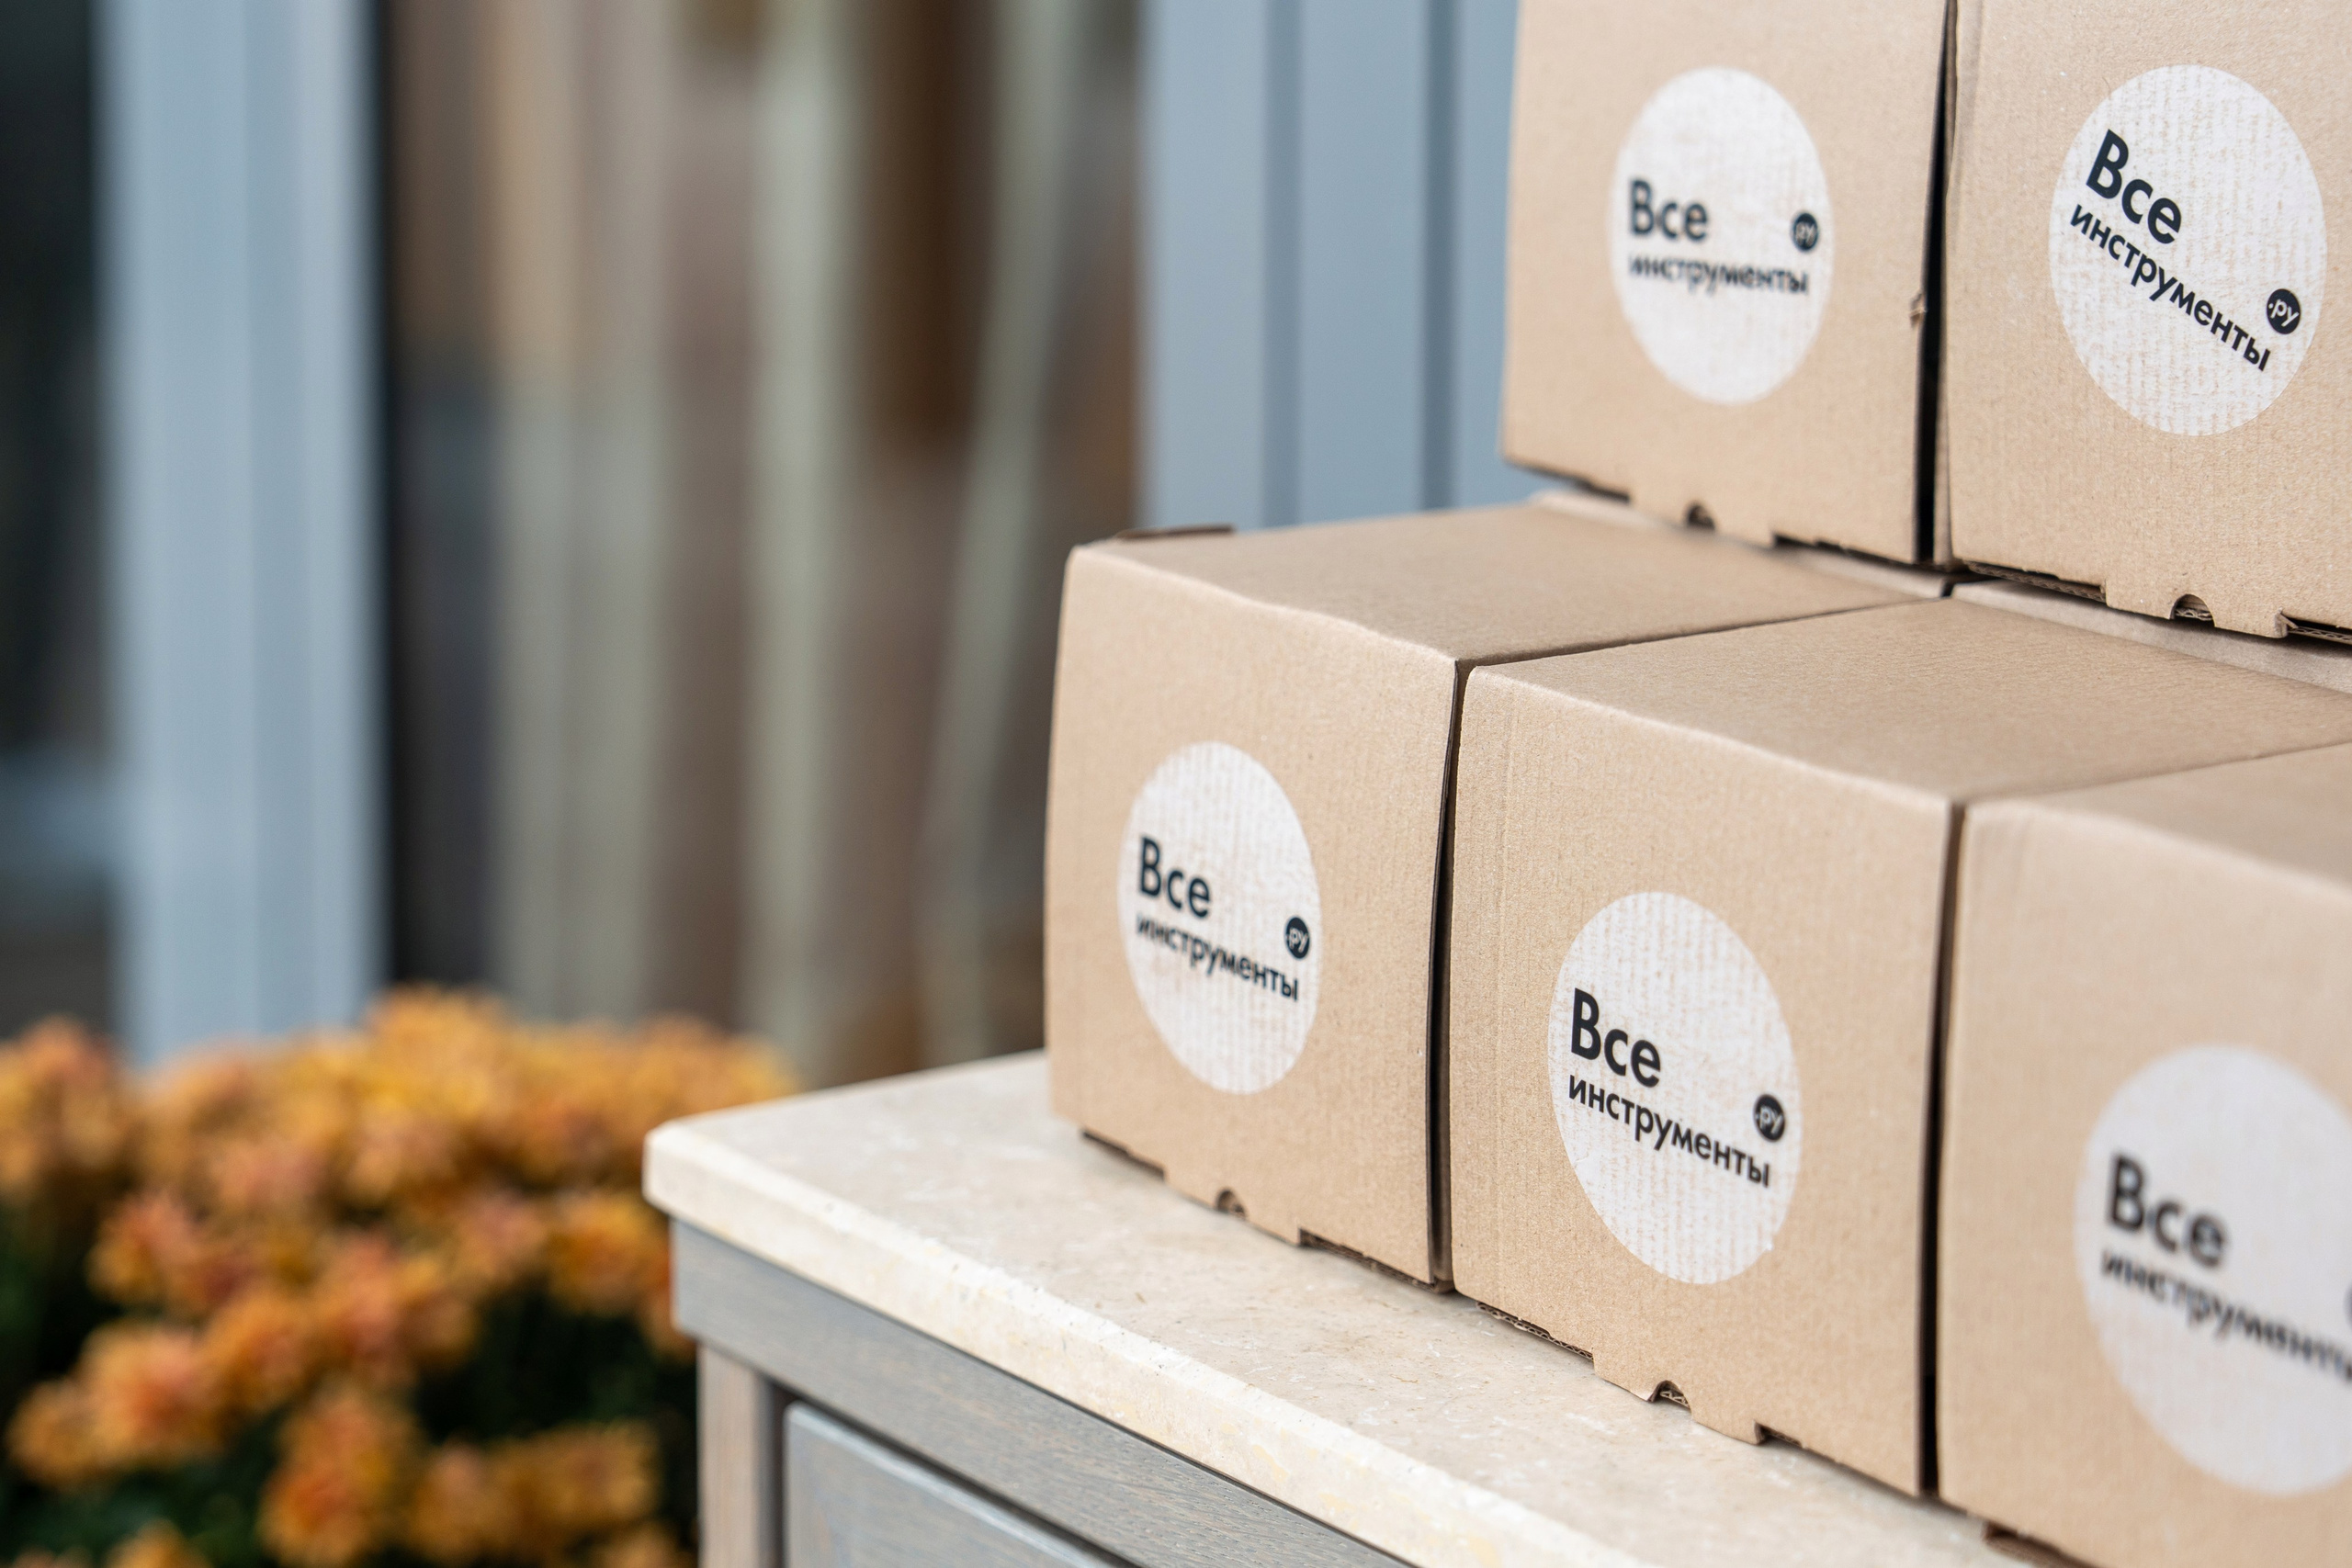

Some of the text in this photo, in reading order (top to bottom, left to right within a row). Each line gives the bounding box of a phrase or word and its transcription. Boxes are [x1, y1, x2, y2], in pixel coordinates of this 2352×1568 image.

[1629, 178, 1708, 241] Все
[2086, 129, 2182, 244] Все
[1629, 253, 1809, 296] инструменты
[2070, 204, 2270, 371] инструменты
[1139, 834, 1211, 919] Все
[1136, 912, 1298, 1001] инструменты
[1571, 987, 1661, 1088] Все
[1568, 1074, 1770, 1188] инструменты
[2109, 1154, 2228, 1269] Все
